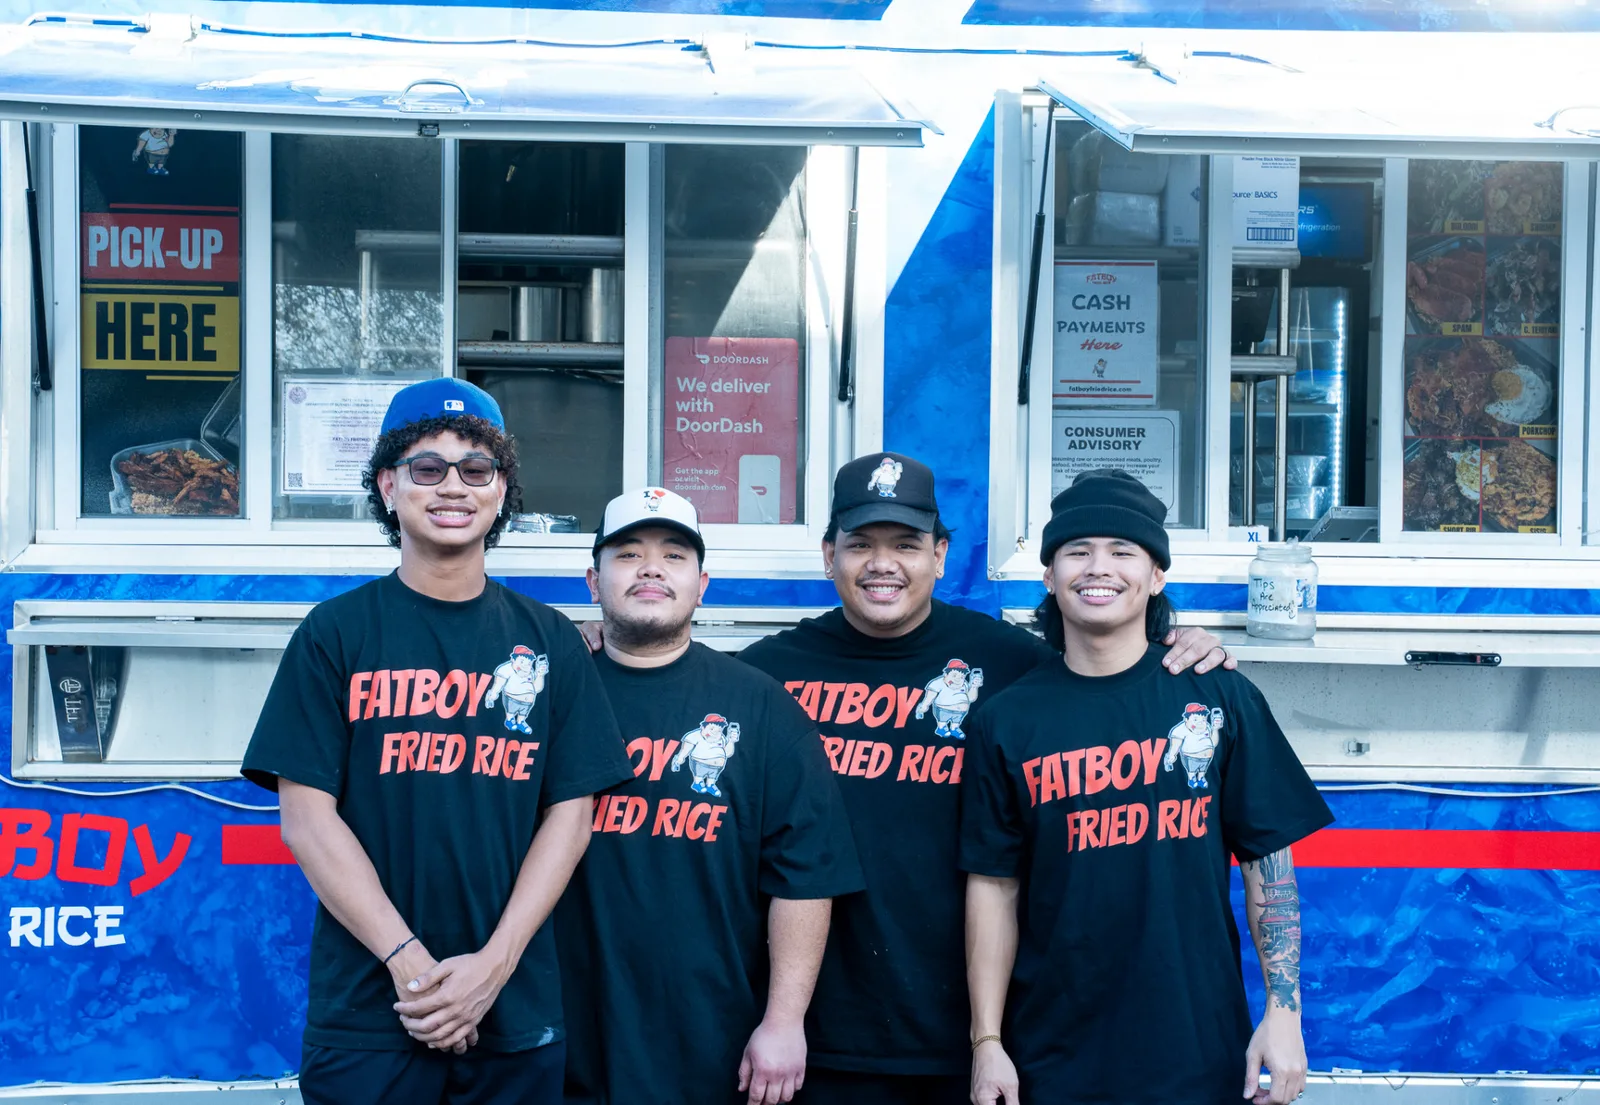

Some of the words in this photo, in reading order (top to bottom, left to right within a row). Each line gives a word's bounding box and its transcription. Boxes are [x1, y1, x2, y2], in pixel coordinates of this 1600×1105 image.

[88, 226, 223, 270] PICK-UP
[1072, 294, 1130, 310] CASH
[96, 301, 218, 362] HERE
[1056, 321, 1146, 334] PAYMENTS
[1452, 324, 1472, 332] SPAM
[1080, 338, 1123, 350] Here
[713, 356, 769, 364] DOORDASH
[676, 376, 707, 392] We
[711, 378, 772, 393] deliver
[676, 397, 714, 412] with
[676, 417, 763, 434] DoorDash
[1064, 426, 1146, 438] CONSUMER
[1068, 440, 1142, 450] ADVISORY
[1248, 532, 1262, 542] XL
[1260, 592, 1274, 601] Are
[349, 669, 492, 722] FATBOY
[379, 731, 466, 775] FRIED
[472, 736, 540, 780] RICE
[819, 734, 893, 779] RIED
[1022, 738, 1167, 808] FATBOY
[592, 795, 648, 834] IED
[652, 798, 728, 842] RICE
[1066, 802, 1149, 853] FRIED
[8, 906, 126, 948] RICE
